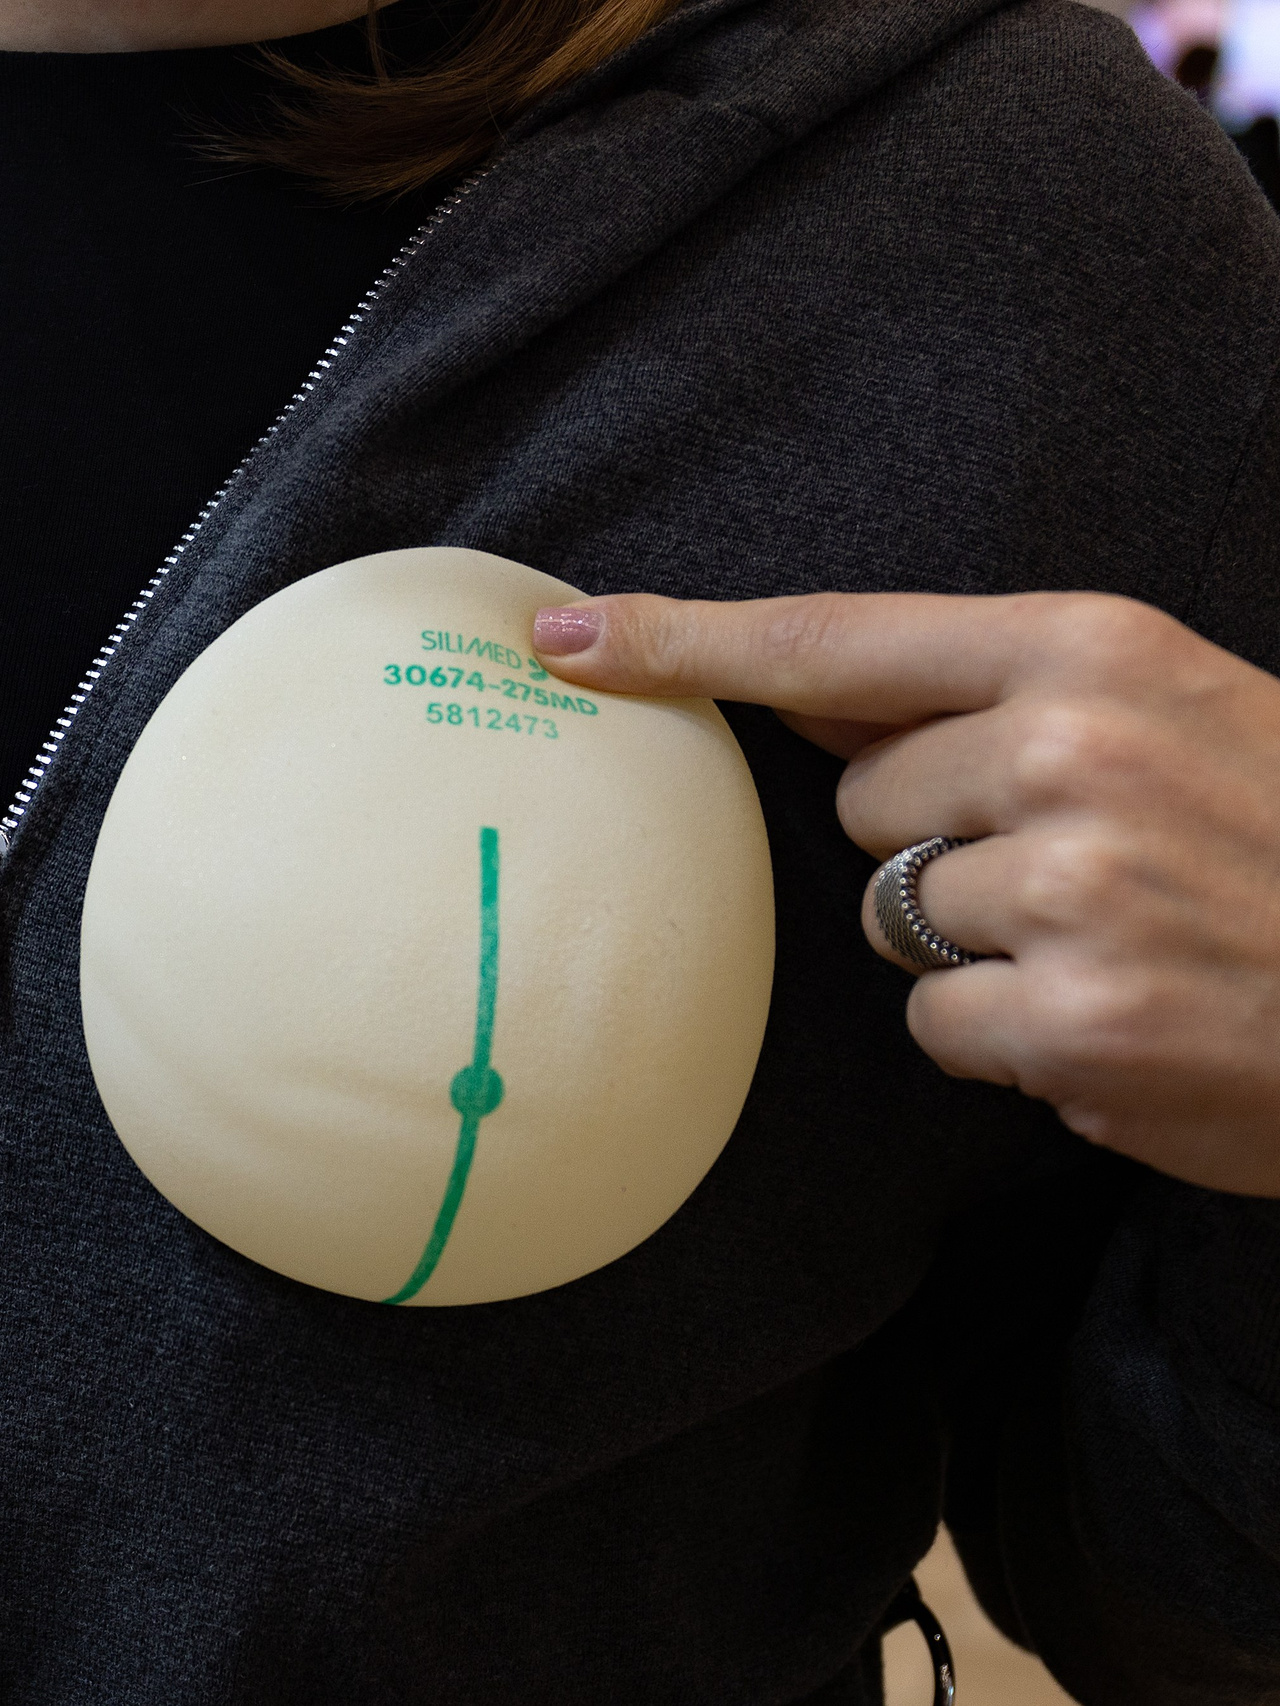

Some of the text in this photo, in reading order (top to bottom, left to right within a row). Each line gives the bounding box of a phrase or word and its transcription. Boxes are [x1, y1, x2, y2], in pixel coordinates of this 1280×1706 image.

[421, 630, 522, 670] SILIMED
[383, 664, 599, 717] 30674-275MD
[426, 702, 559, 740] 5812473
